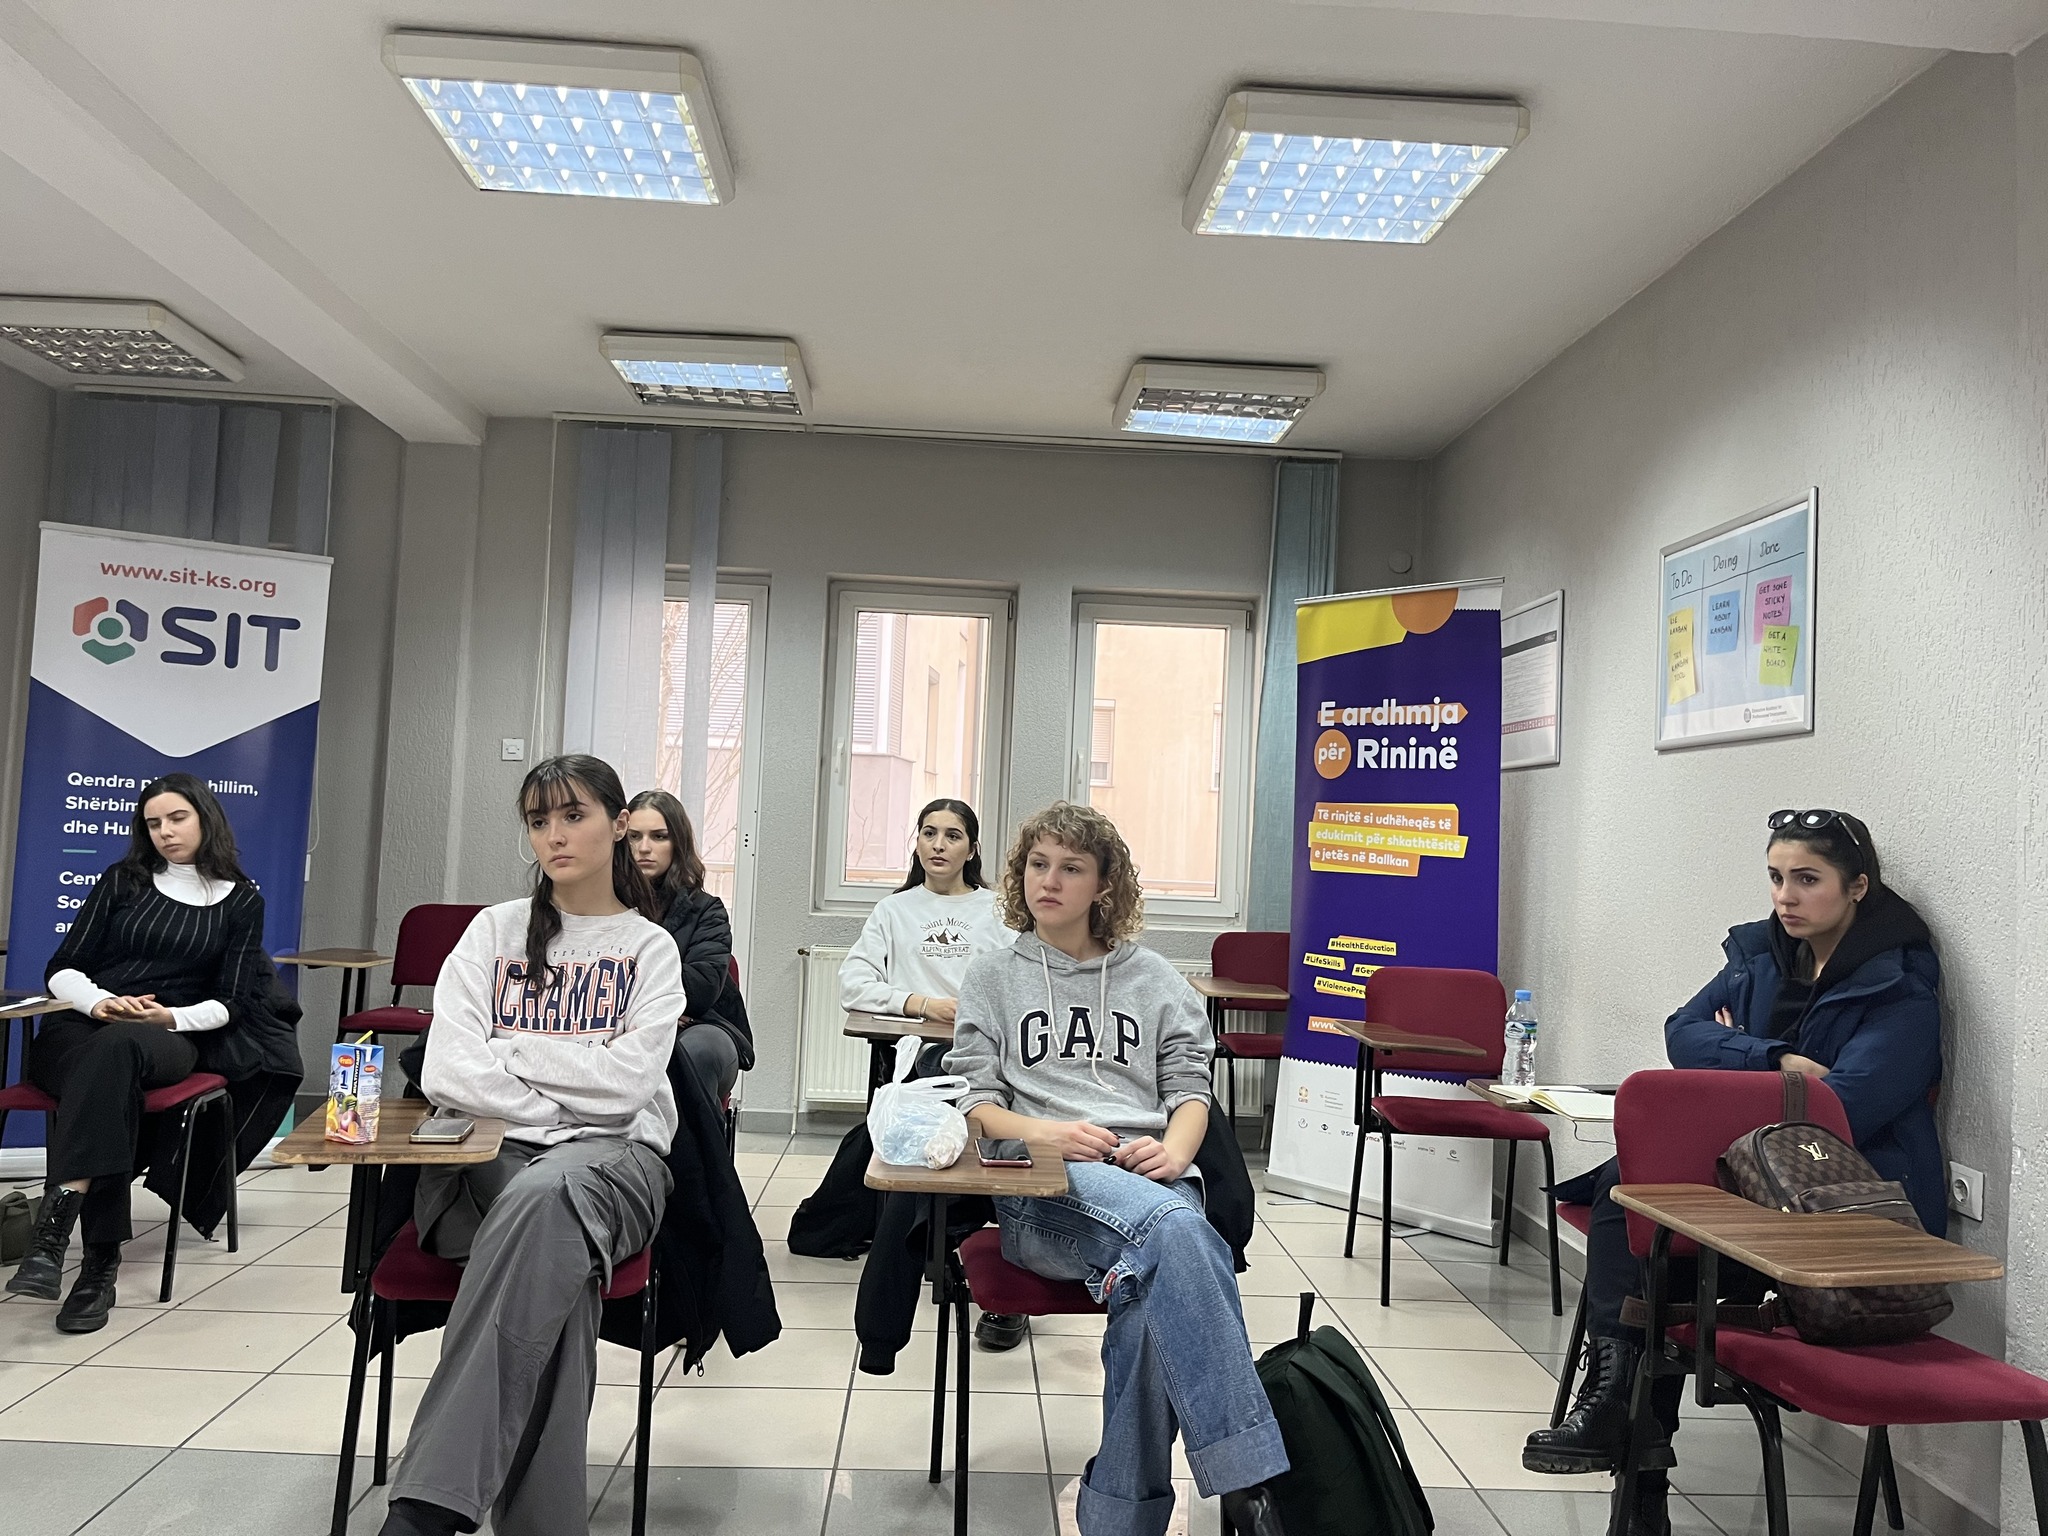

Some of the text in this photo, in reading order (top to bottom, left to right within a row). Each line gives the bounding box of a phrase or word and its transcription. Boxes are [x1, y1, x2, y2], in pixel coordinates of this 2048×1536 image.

[1760, 541, 1780, 557] Done
[1713, 555, 1738, 572] Doing
[100, 562, 277, 598] www.sit-ks.org
[1671, 569, 1692, 590] To Do
[1758, 585, 1770, 595] GET
[1711, 600, 1730, 611] LEARN
[1764, 594, 1785, 606] STICKY
[1714, 612, 1731, 622] ABOUT
[1710, 624, 1733, 635] KANBAN
[1768, 631, 1786, 641] GET A
[160, 606, 301, 672] SIT
[1320, 696, 1459, 732] E ardhmja
[1318, 736, 1459, 770] për Rininë
[67, 772, 136, 789] Qendra
[207, 780, 259, 796] hillim,
[63, 820, 133, 836] dhe Hu
[1318, 809, 1451, 831] Të rinjtë si udhëheqës të
[1316, 829, 1461, 852] edukimit për shkathtësitë
[1314, 848, 1409, 868] e jetës në Ballkan
[920, 917, 973, 932] Saint Moritz
[921, 945, 970, 954] ALPINE RETREAT
[1331, 940, 1395, 953] #HealthEducation
[1305, 955, 1341, 968] #LifeSkills
[1355, 966, 1375, 975] #Gen
[1316, 979, 1366, 995] #ViolencePrev
[1017, 1005, 1142, 1070] GAP
